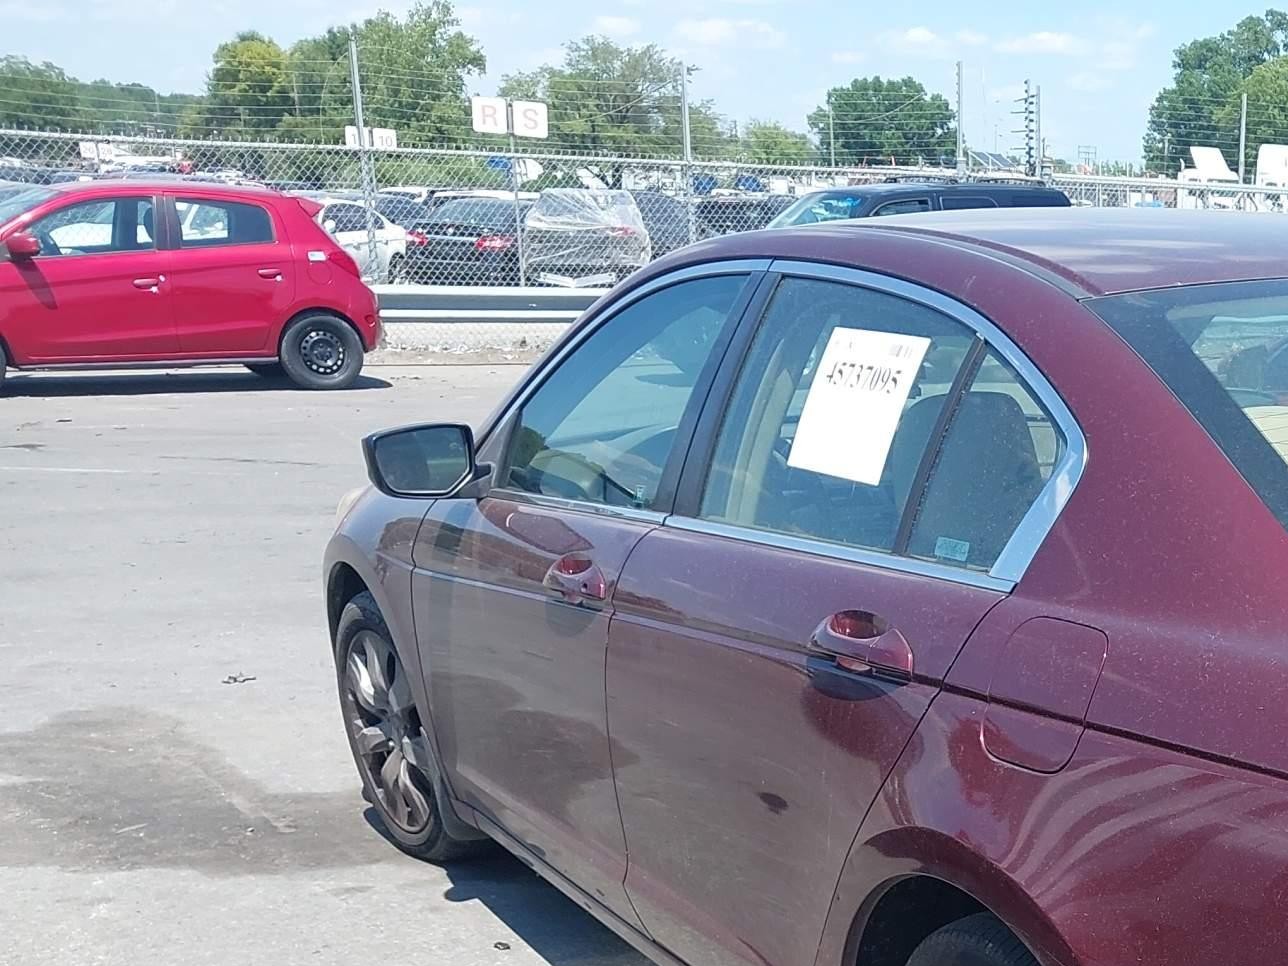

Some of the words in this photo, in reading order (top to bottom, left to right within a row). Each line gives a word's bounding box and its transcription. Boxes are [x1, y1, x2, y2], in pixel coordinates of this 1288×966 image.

[481, 104, 498, 127] R
[522, 108, 539, 130] S
[378, 135, 393, 148] 10
[826, 360, 903, 394] 45737095
